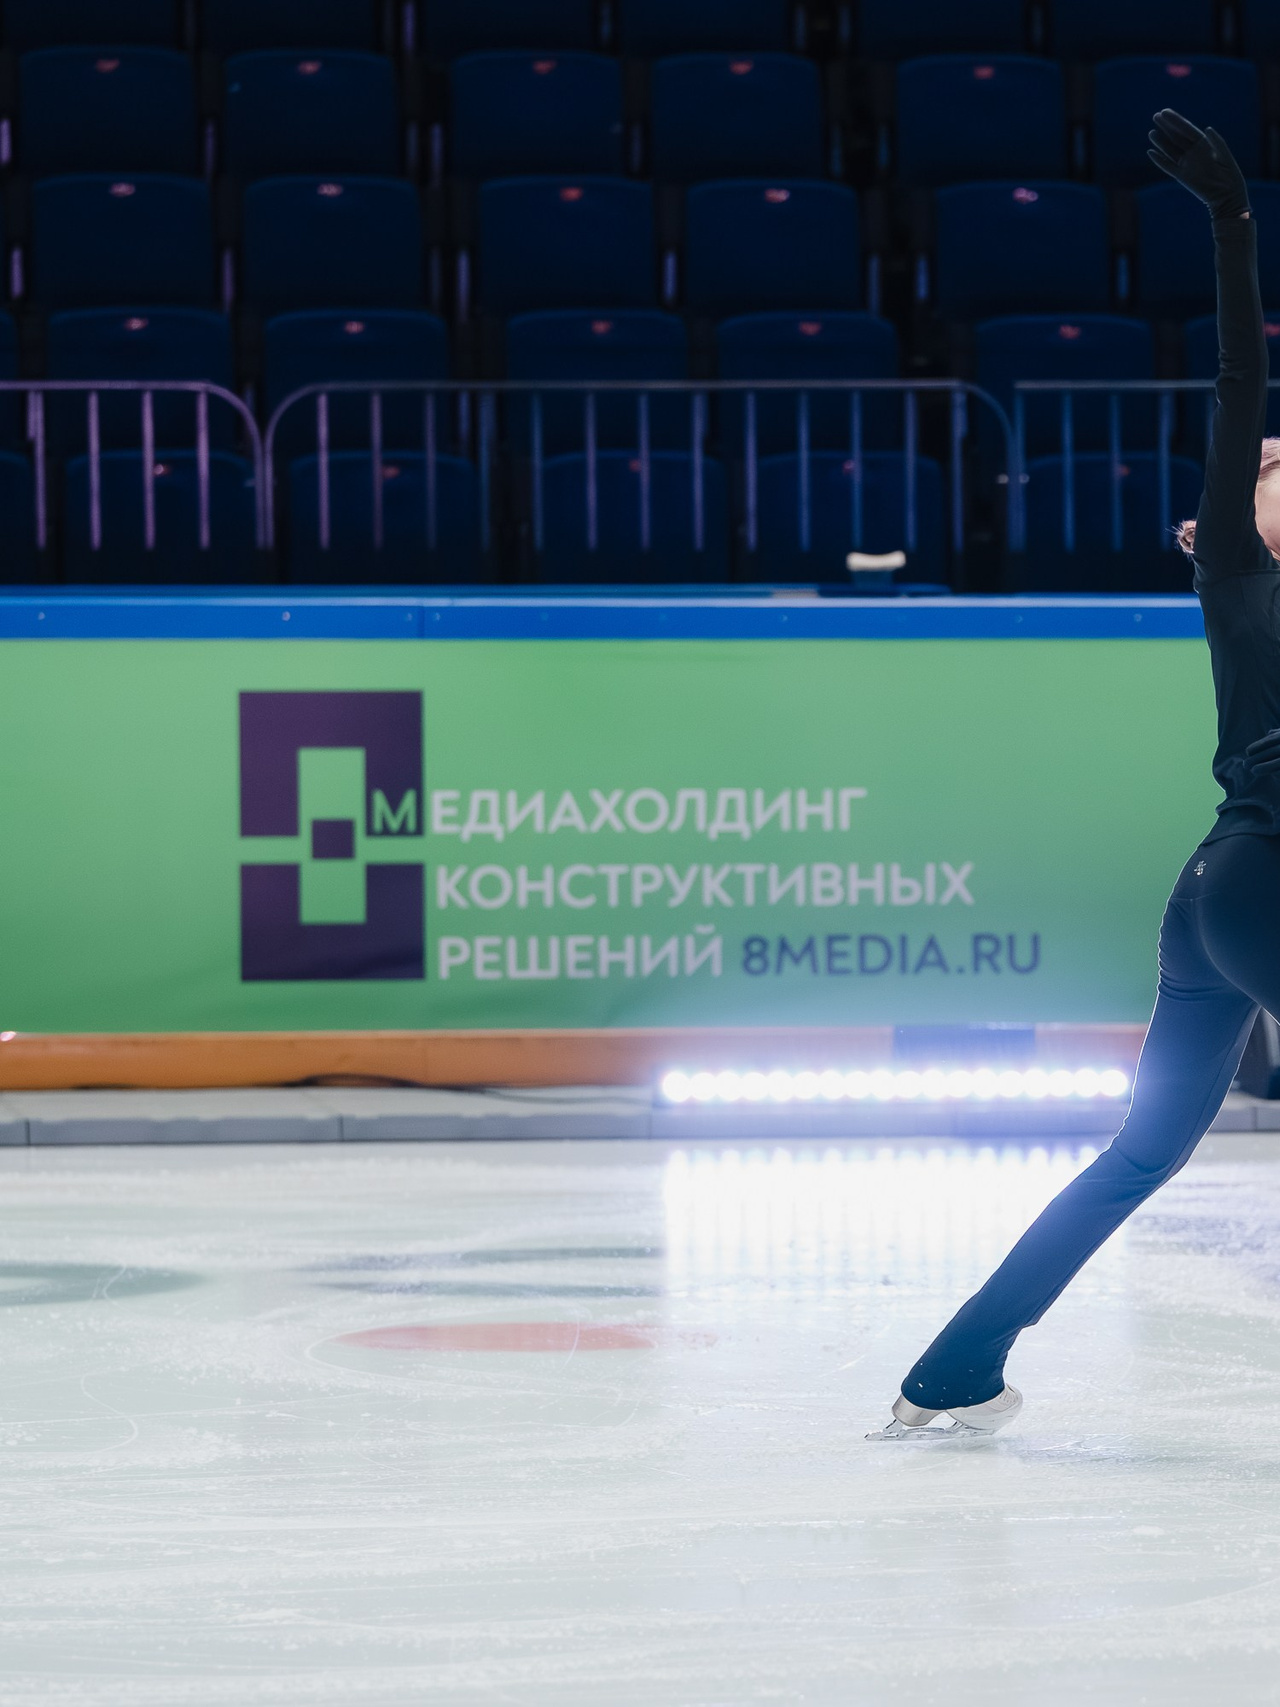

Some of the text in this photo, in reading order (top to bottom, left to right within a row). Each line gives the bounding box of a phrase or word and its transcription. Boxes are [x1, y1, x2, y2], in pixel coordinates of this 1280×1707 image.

[373, 788, 867, 842] МЕДИАХОЛДИНГ
[436, 862, 974, 908] КОНСТРУКТИВНЫХ
[438, 924, 1041, 980] РЕШЕНИЙ 8MEDIA.RU
